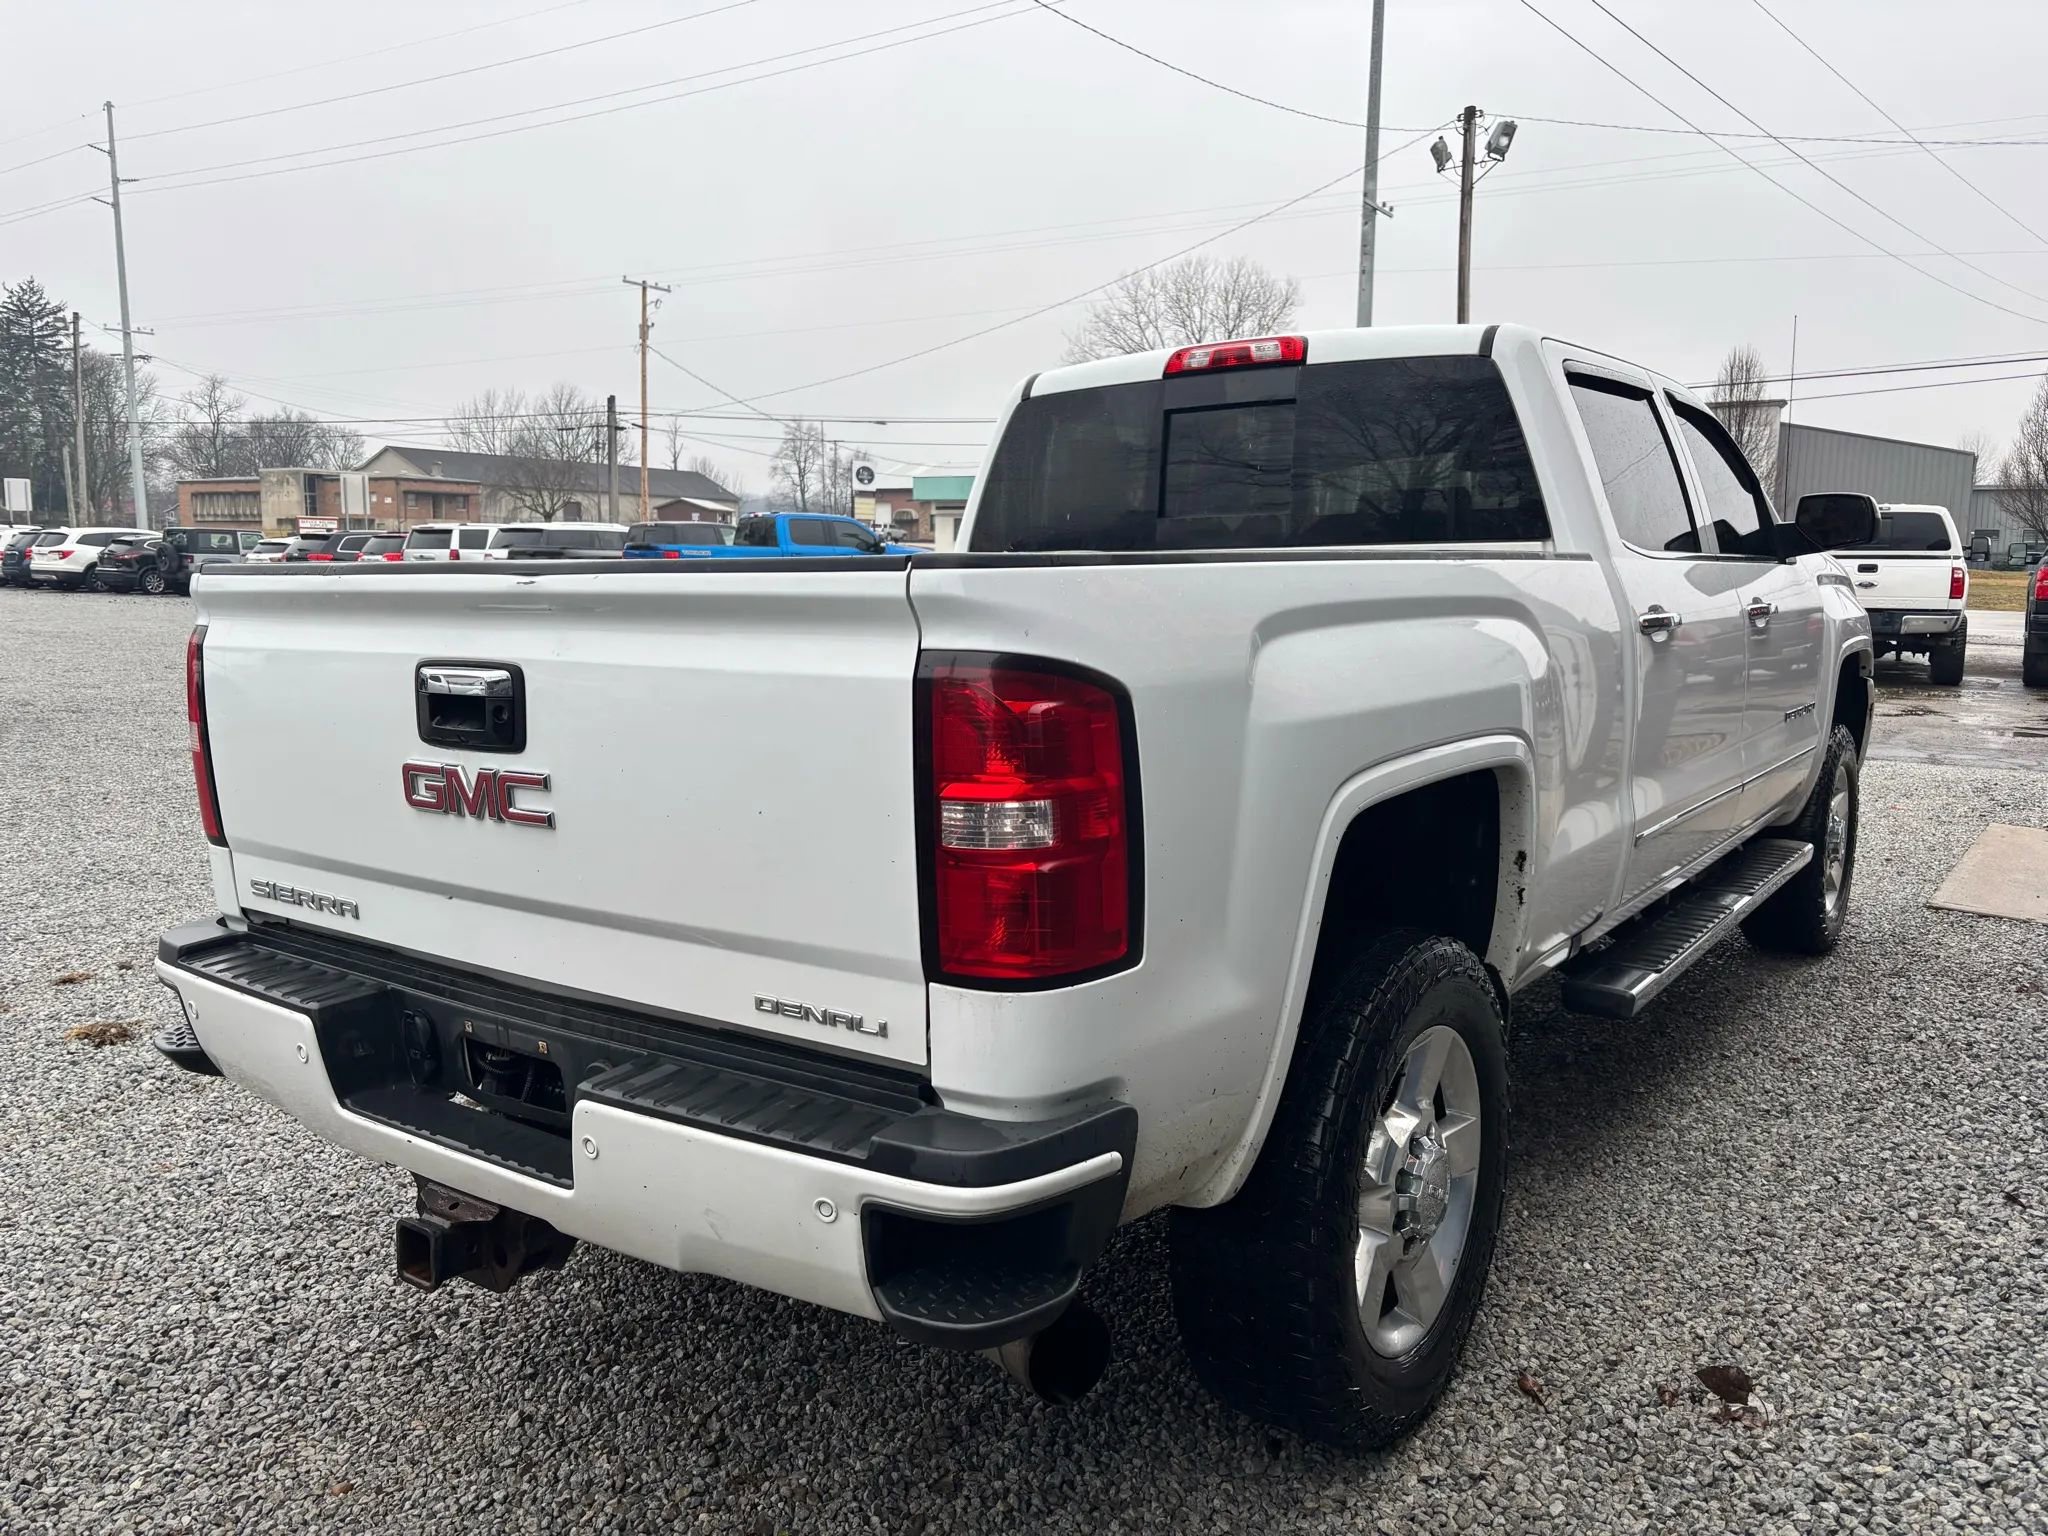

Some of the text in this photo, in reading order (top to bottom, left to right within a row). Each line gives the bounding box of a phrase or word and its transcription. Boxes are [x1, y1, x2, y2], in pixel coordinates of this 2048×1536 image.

[402, 759, 556, 830] GMC
[250, 878, 360, 920] SIERRA
[754, 993, 888, 1039] DENALI
